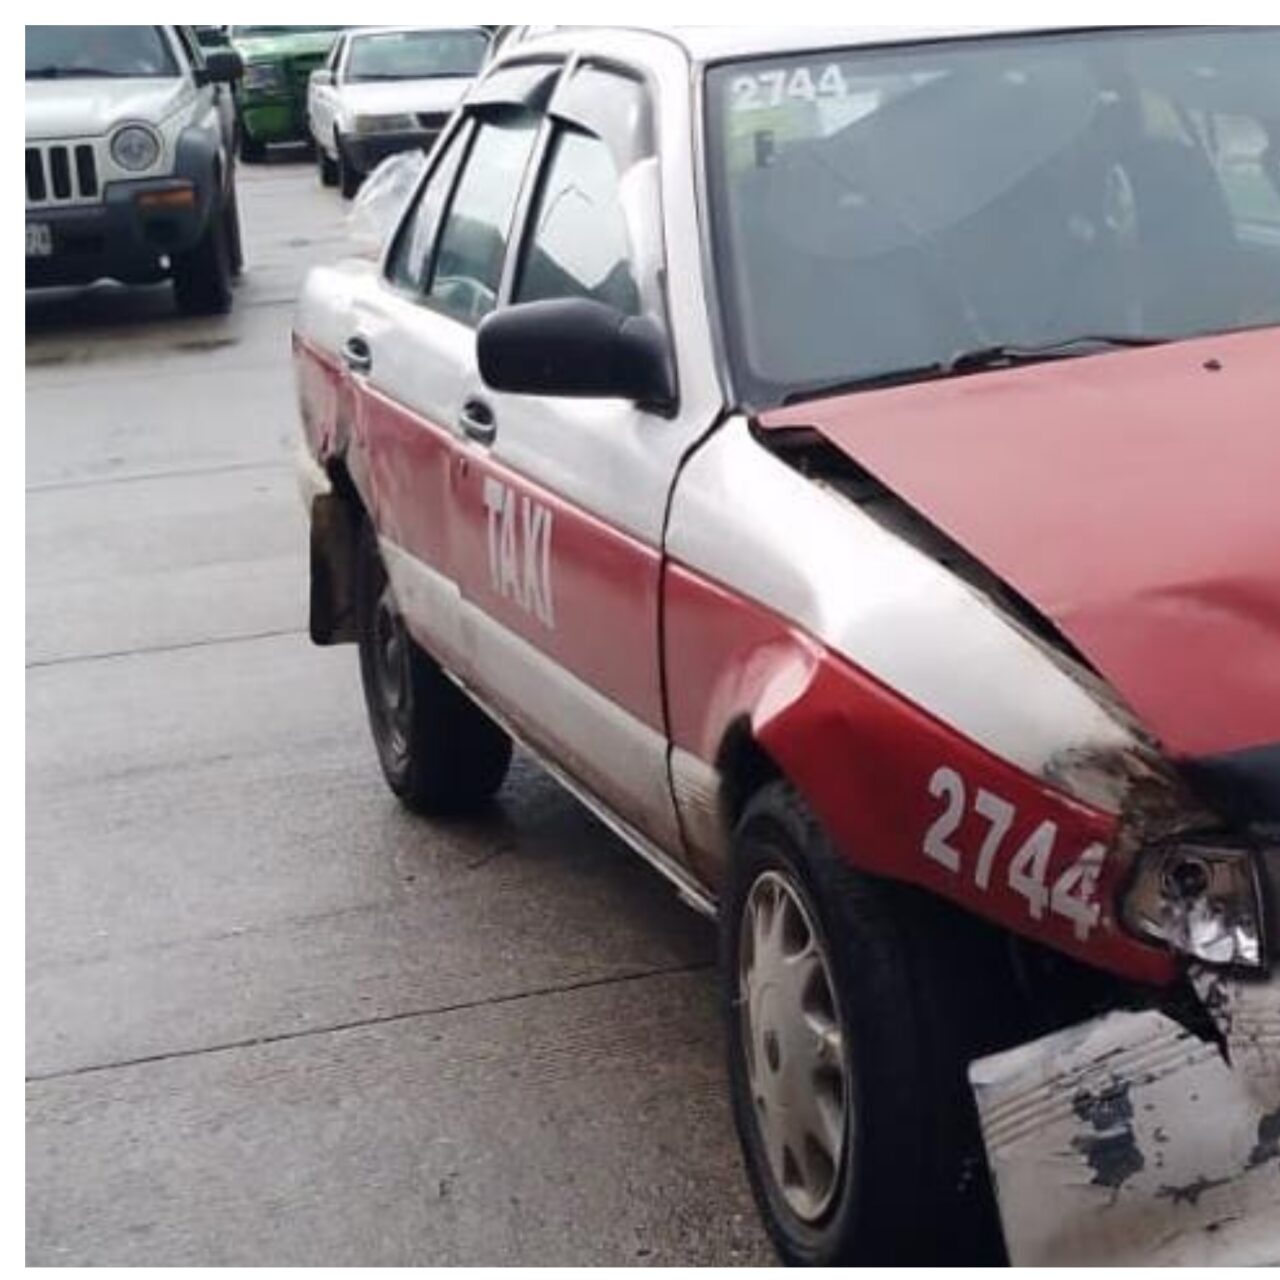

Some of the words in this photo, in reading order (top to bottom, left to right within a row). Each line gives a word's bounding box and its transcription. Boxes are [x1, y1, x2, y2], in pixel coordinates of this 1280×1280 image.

[731, 64, 848, 111] 2744
[484, 475, 555, 630] TAXI
[923, 765, 1107, 940] 2744
